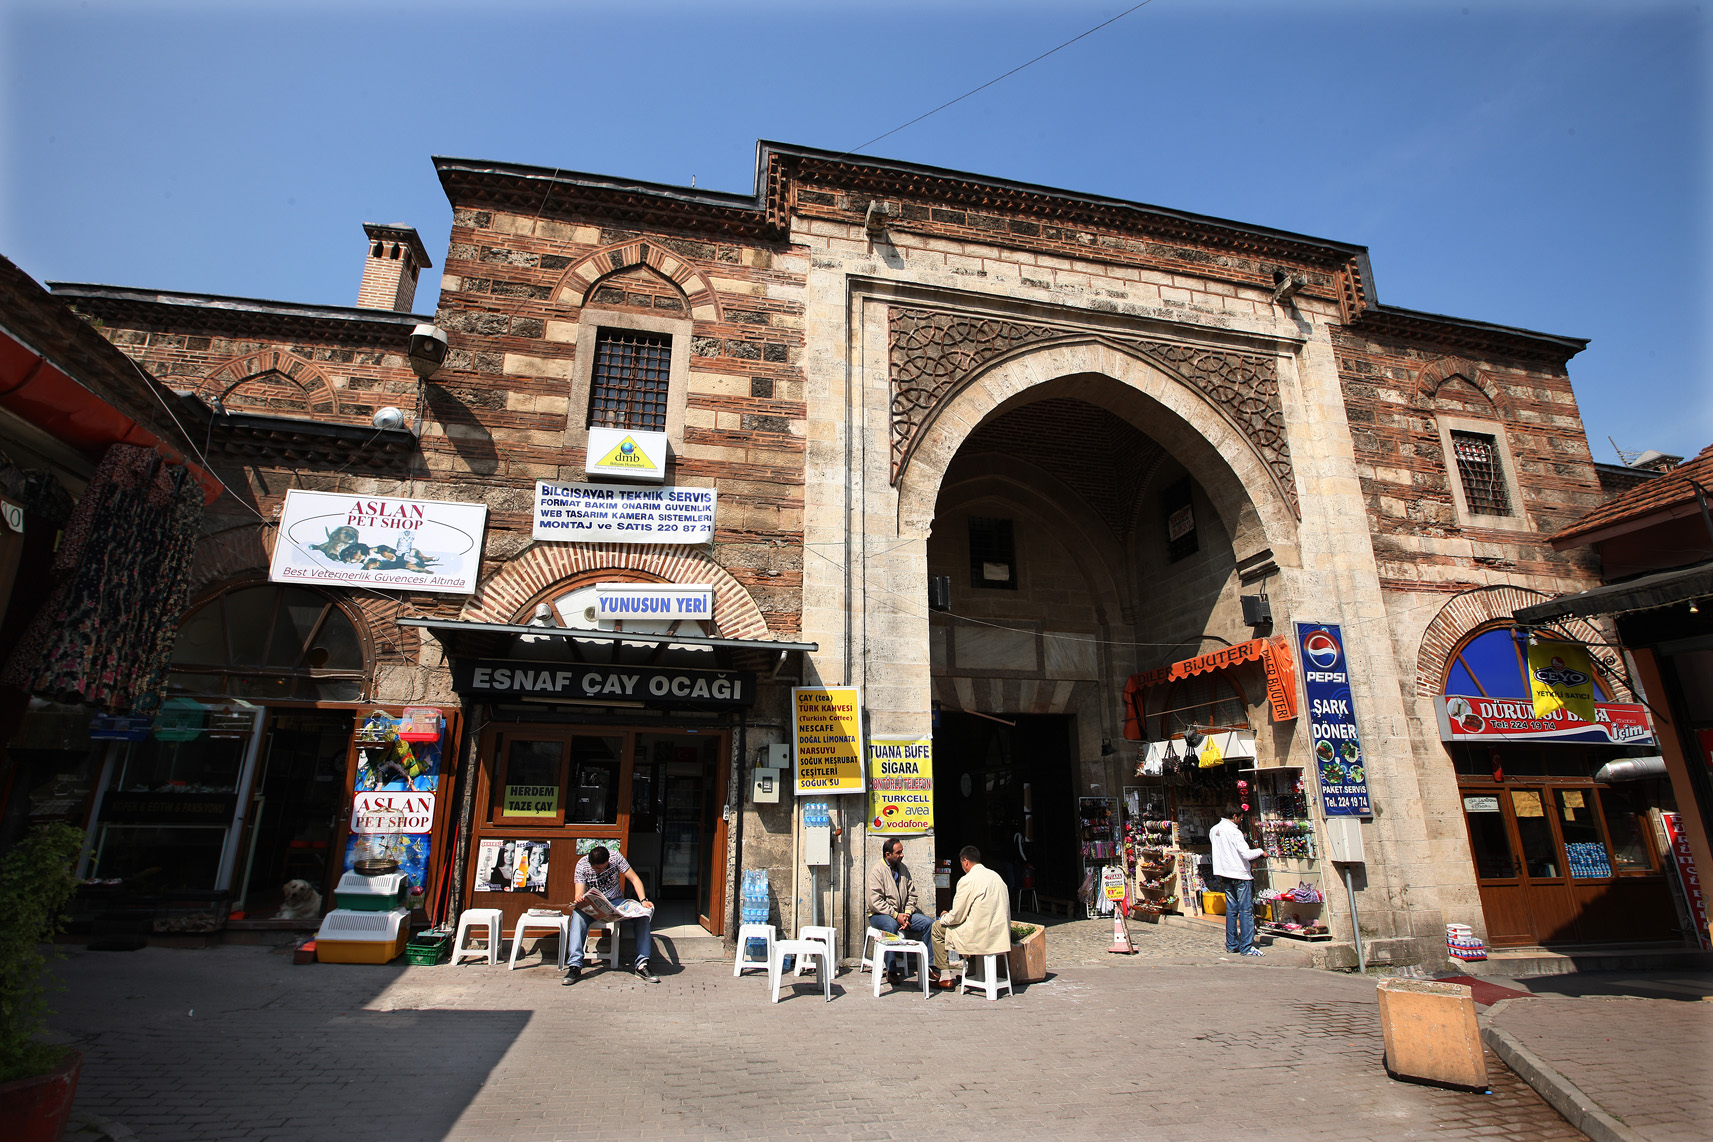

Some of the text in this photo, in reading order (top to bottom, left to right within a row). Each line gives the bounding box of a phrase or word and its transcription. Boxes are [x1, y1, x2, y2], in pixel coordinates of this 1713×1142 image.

[615, 453, 640, 462] dmb
[542, 486, 712, 503] BILGISAYAR TEKNIK SERVIS
[349, 501, 426, 519] ASLAN
[541, 499, 581, 507] FORMAT
[665, 504, 712, 512] GUVENLIK
[566, 510, 608, 519] TASARIM
[612, 512, 654, 521] KAMERA
[659, 514, 712, 522] SISTEMLERI
[347, 515, 423, 530] PET SHOP
[540, 521, 593, 529] MONTAJ
[617, 523, 652, 531] SATIS
[283, 567, 466, 587] Best Veterinerlik Güvencesi Altında
[600, 594, 707, 613] YUNUSUN YERİ
[1307, 672, 1346, 683] PEPSI
[1536, 672, 1584, 682] CEYO
[472, 668, 742, 700] ESNAF ÇAY OCAĞI
[799, 695, 833, 704] ÇAY (tea)
[799, 703, 853, 712] TÜRK KAHVESİ
[1314, 699, 1349, 717] ŞARK
[1313, 721, 1357, 739] DÖNER
[1491, 720, 1508, 729] Tel:
[1531, 722, 1542, 730] 19
[1544, 722, 1556, 730] 74
[1612, 723, 1644, 741] İçim
[800, 734, 856, 744] DOĞAL LİMONATA
[800, 747, 836, 755] NARSUYU
[869, 743, 930, 759] TUANA BÜFE
[801, 756, 858, 766] SOĞUK MEŞRUBAT
[801, 767, 838, 778] ÇEŞİTLERİ
[882, 760, 919, 774] SİGARA
[802, 778, 827, 788] SOĞUK
[904, 778, 932, 790] TELEFON
[510, 786, 555, 797] HERDEM
[1323, 786, 1343, 794] PAKET
[882, 795, 930, 803] TURKCELL
[1325, 797, 1368, 807] Tel. 224 19 74
[356, 798, 432, 813] ASLAN
[509, 802, 553, 814] TAZE ÇAY
[905, 807, 930, 816] avea
[356, 817, 429, 828] PET SHOP
[887, 820, 928, 828] vodafone
